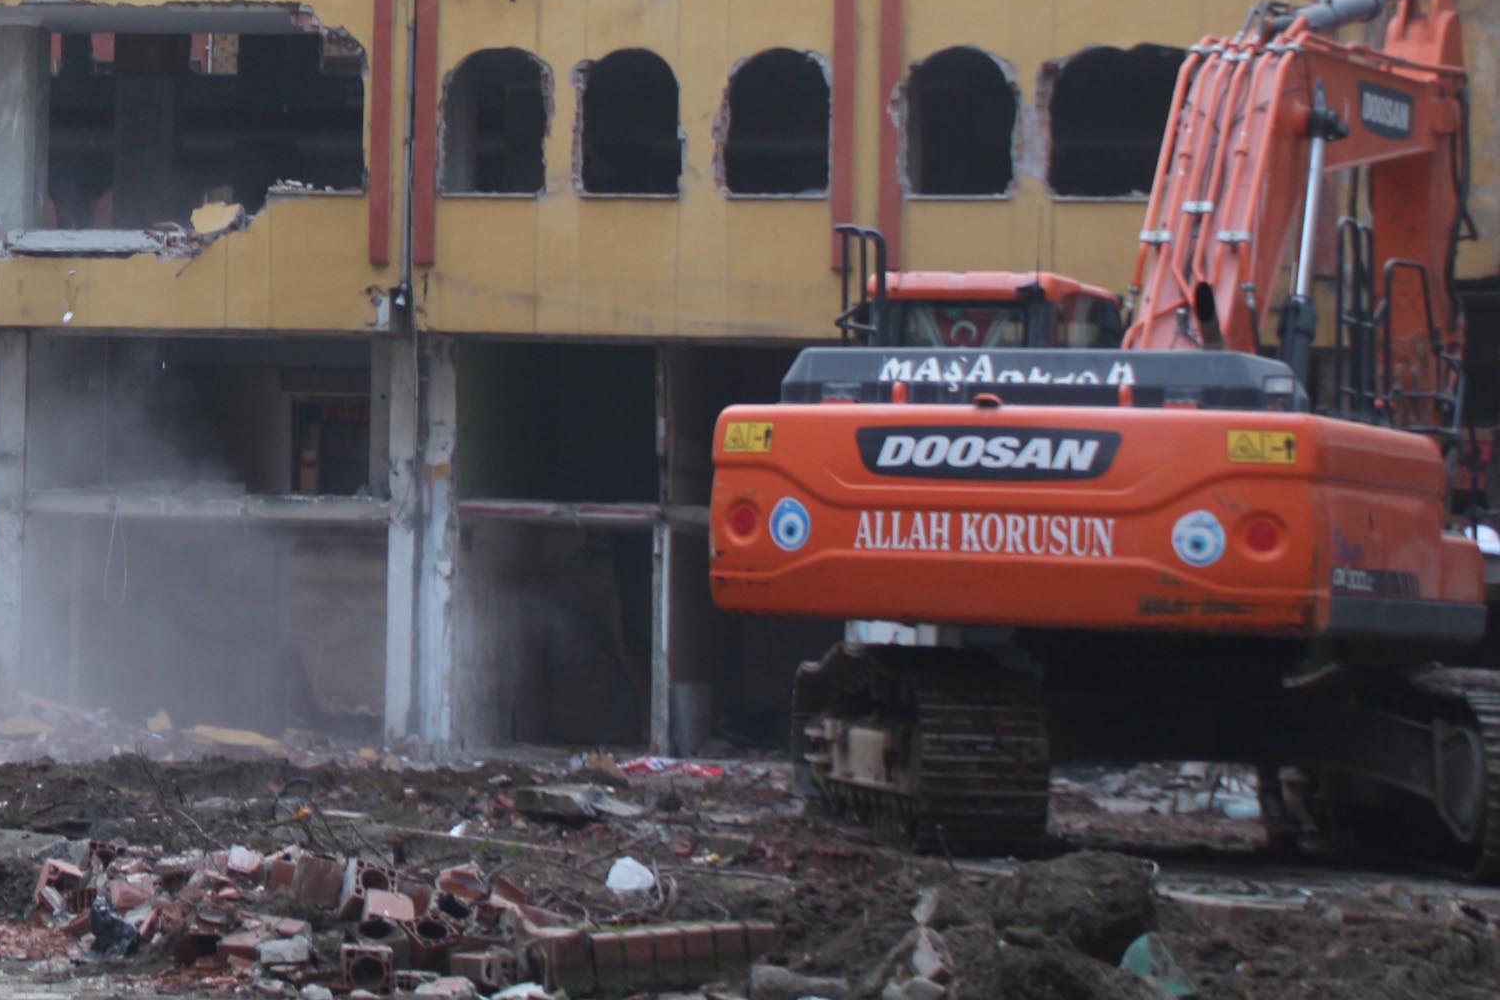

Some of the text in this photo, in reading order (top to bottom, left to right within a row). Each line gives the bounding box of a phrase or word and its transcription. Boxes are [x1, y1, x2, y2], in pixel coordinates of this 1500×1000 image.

[1363, 91, 1409, 131] DOOSAN
[876, 435, 1099, 471] DOOSAN
[854, 510, 1115, 558] ALLAH KORUSUN
